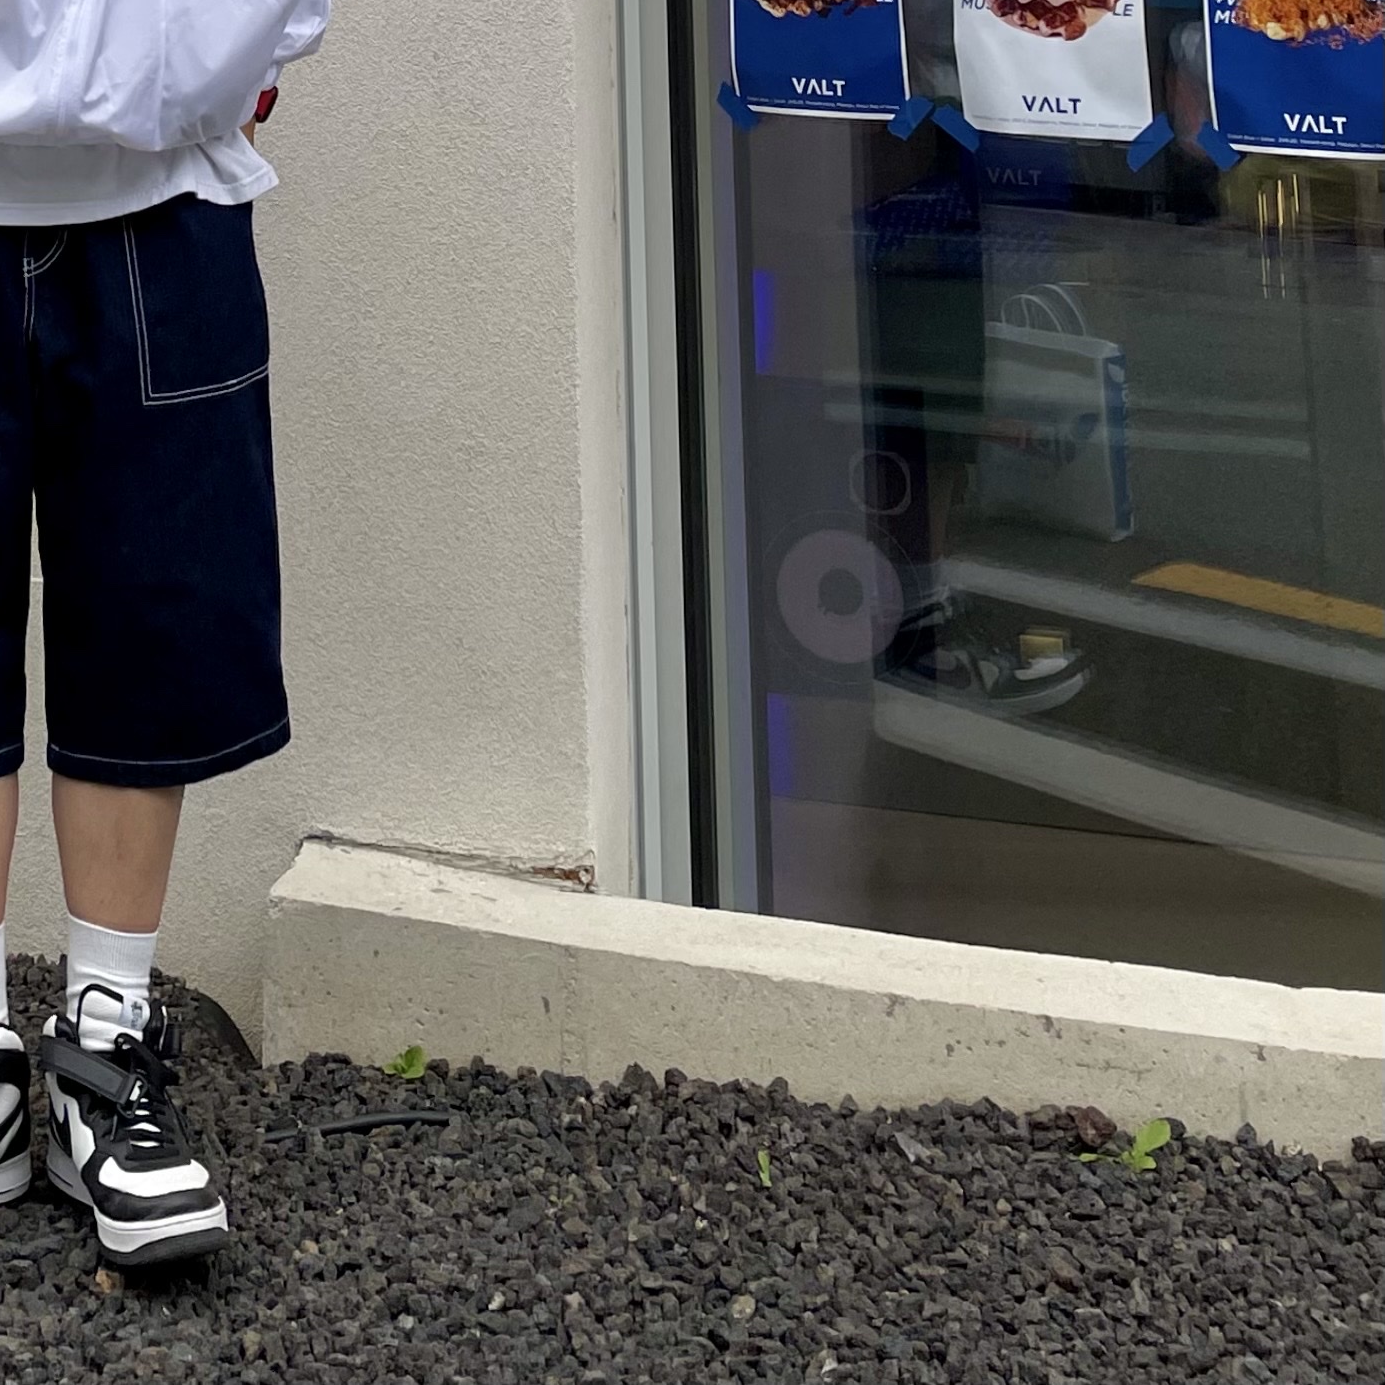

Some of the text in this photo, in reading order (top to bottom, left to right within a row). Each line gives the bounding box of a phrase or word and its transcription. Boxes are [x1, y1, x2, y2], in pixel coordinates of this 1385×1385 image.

[791, 77, 846, 97] VALT
[1021, 95, 1081, 114] VALT
[1283, 113, 1347, 134] VALT
